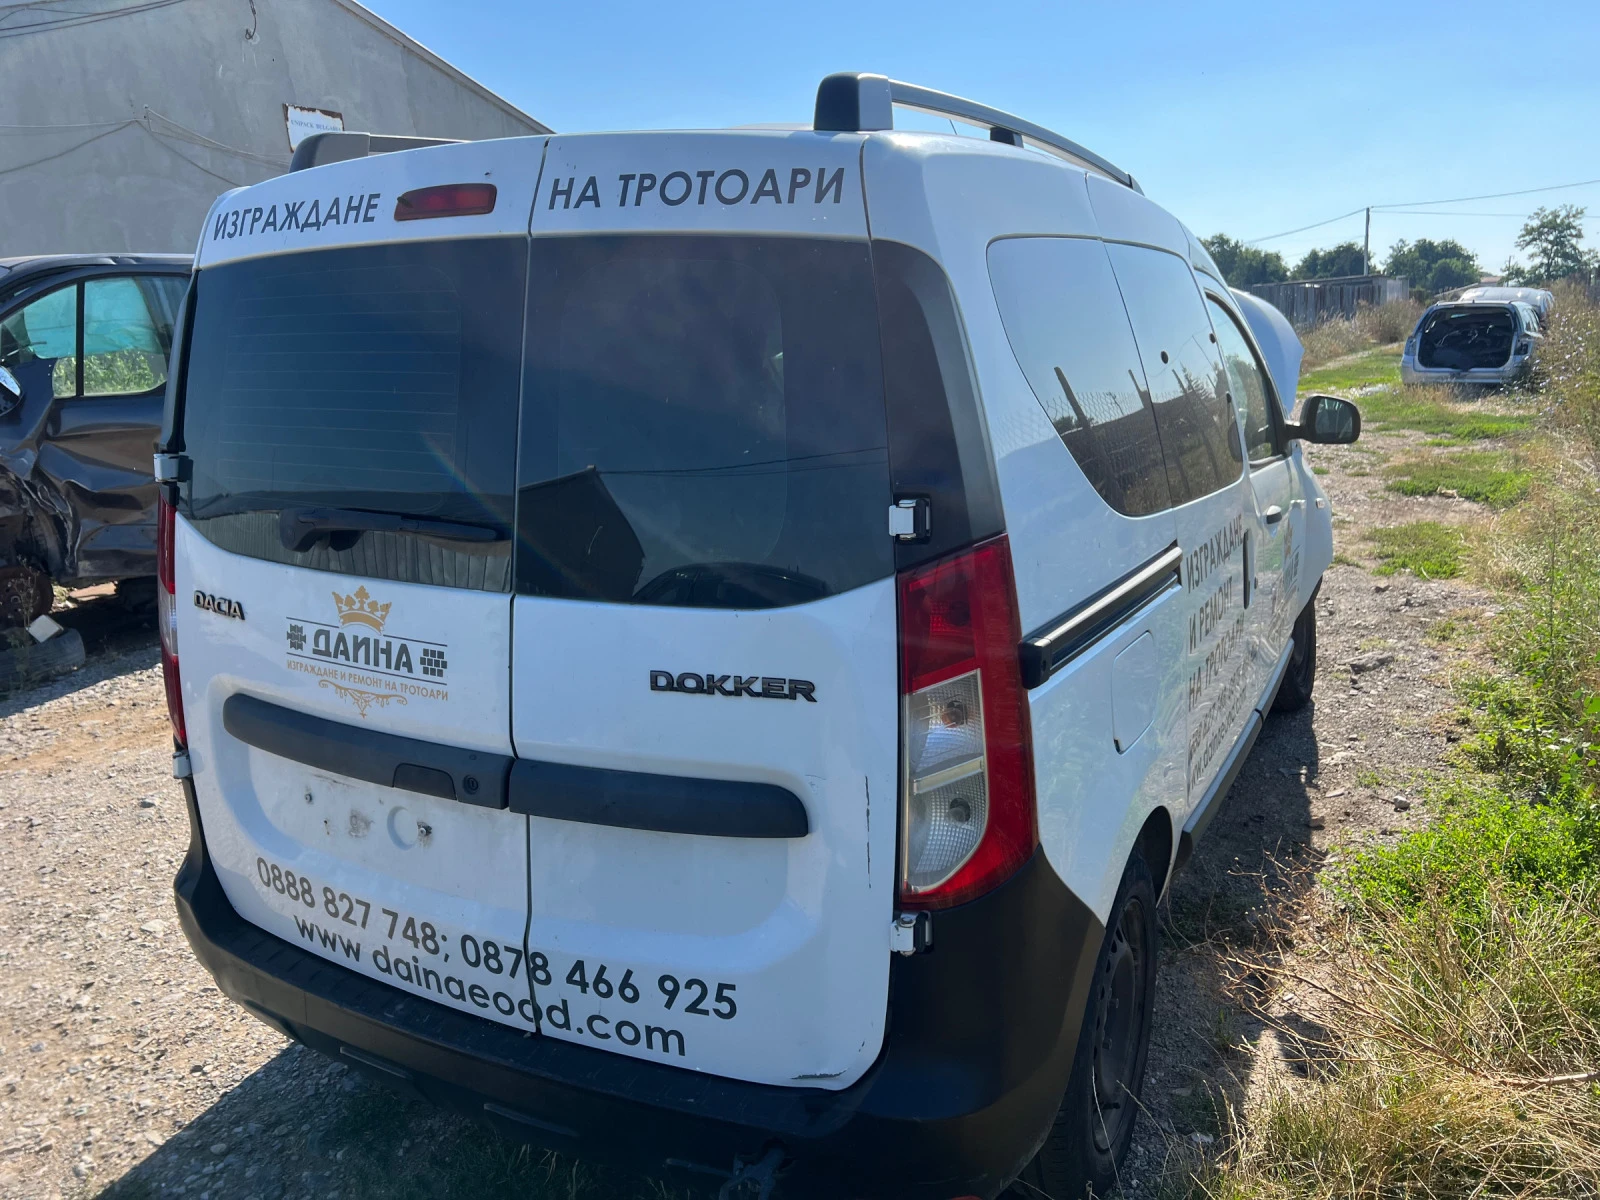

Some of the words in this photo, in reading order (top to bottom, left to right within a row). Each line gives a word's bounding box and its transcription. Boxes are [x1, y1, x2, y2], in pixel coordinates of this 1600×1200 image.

[213, 193, 381, 241] ИЗГРАЖДАНЕ
[548, 175, 601, 210] НА
[618, 167, 845, 207] ТРОТОАРИ
[1186, 513, 1243, 594] ИЗГРАЖДАНЕ
[193, 590, 246, 621] DACIA
[1189, 613, 1197, 655] И
[1199, 575, 1233, 643] РЕМОНТ
[286, 660, 339, 681] ИЗГРАЖДАНЕ
[340, 671, 347, 681] И
[348, 672, 383, 689] РЕМОНТ
[385, 680, 398, 692] НА
[400, 683, 449, 701] ТРОТОАРИ
[312, 628, 414, 674] ДАИНА
[650, 670, 818, 702] DOKKER
[1188, 666, 1202, 713] НА
[256, 857, 315, 908] 0888
[322, 886, 371, 930] 827
[381, 907, 450, 963] 748;
[460, 934, 552, 986] 0878
[565, 959, 640, 1004] 466
[657, 974, 737, 1020] 925
[372, 945, 686, 1057] dainaeood.com
